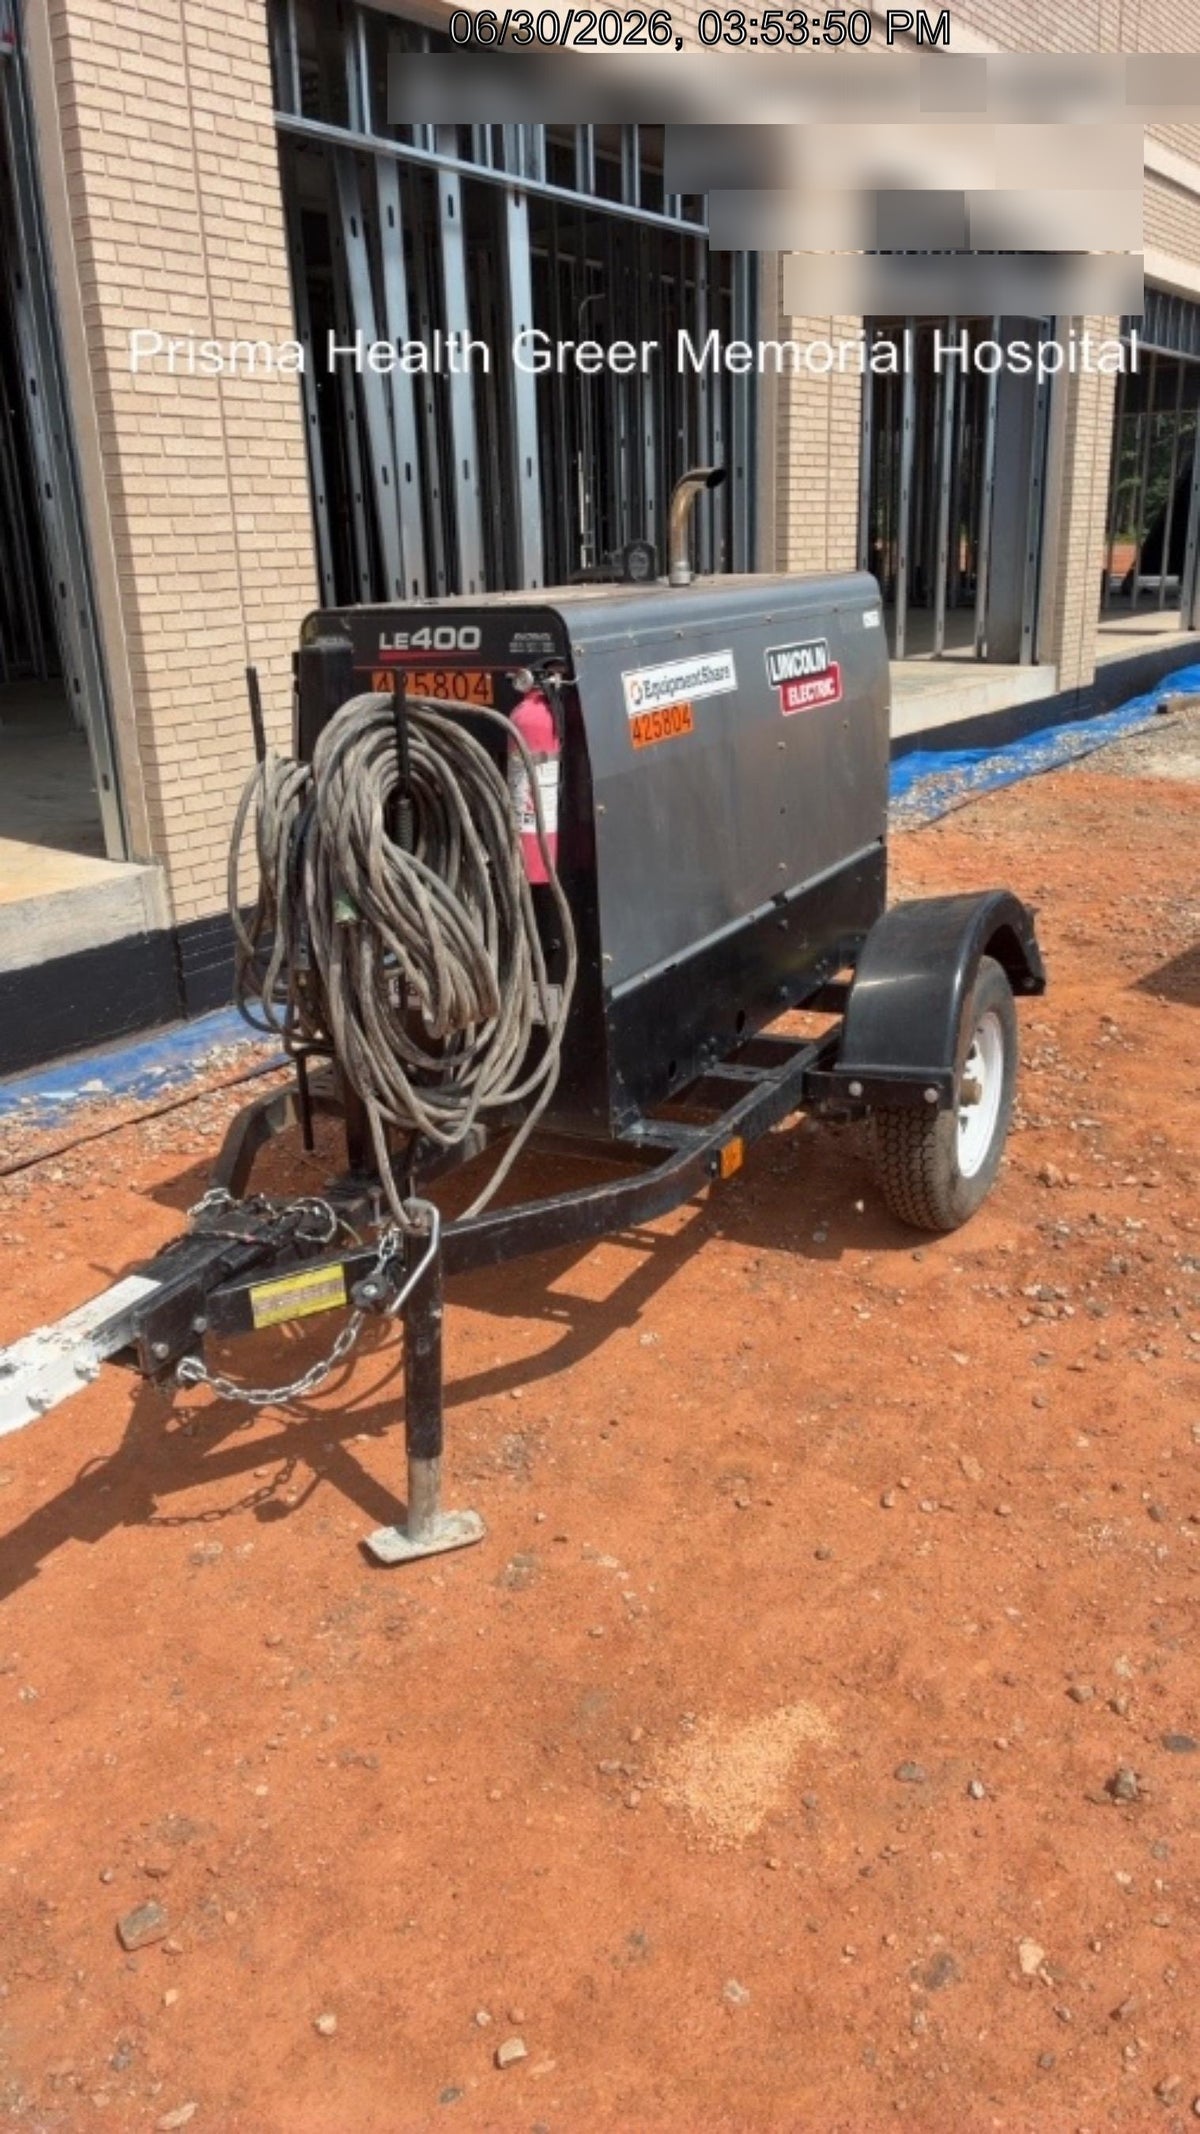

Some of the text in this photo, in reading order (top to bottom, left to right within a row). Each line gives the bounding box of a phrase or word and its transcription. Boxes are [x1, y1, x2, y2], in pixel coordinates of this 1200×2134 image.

[379, 626, 481, 650] LE400
[769, 646, 827, 682] LINCOLN
[376, 671, 490, 701] 45804
[787, 677, 836, 707] ELECTRIC
[633, 702, 691, 742] 425804
